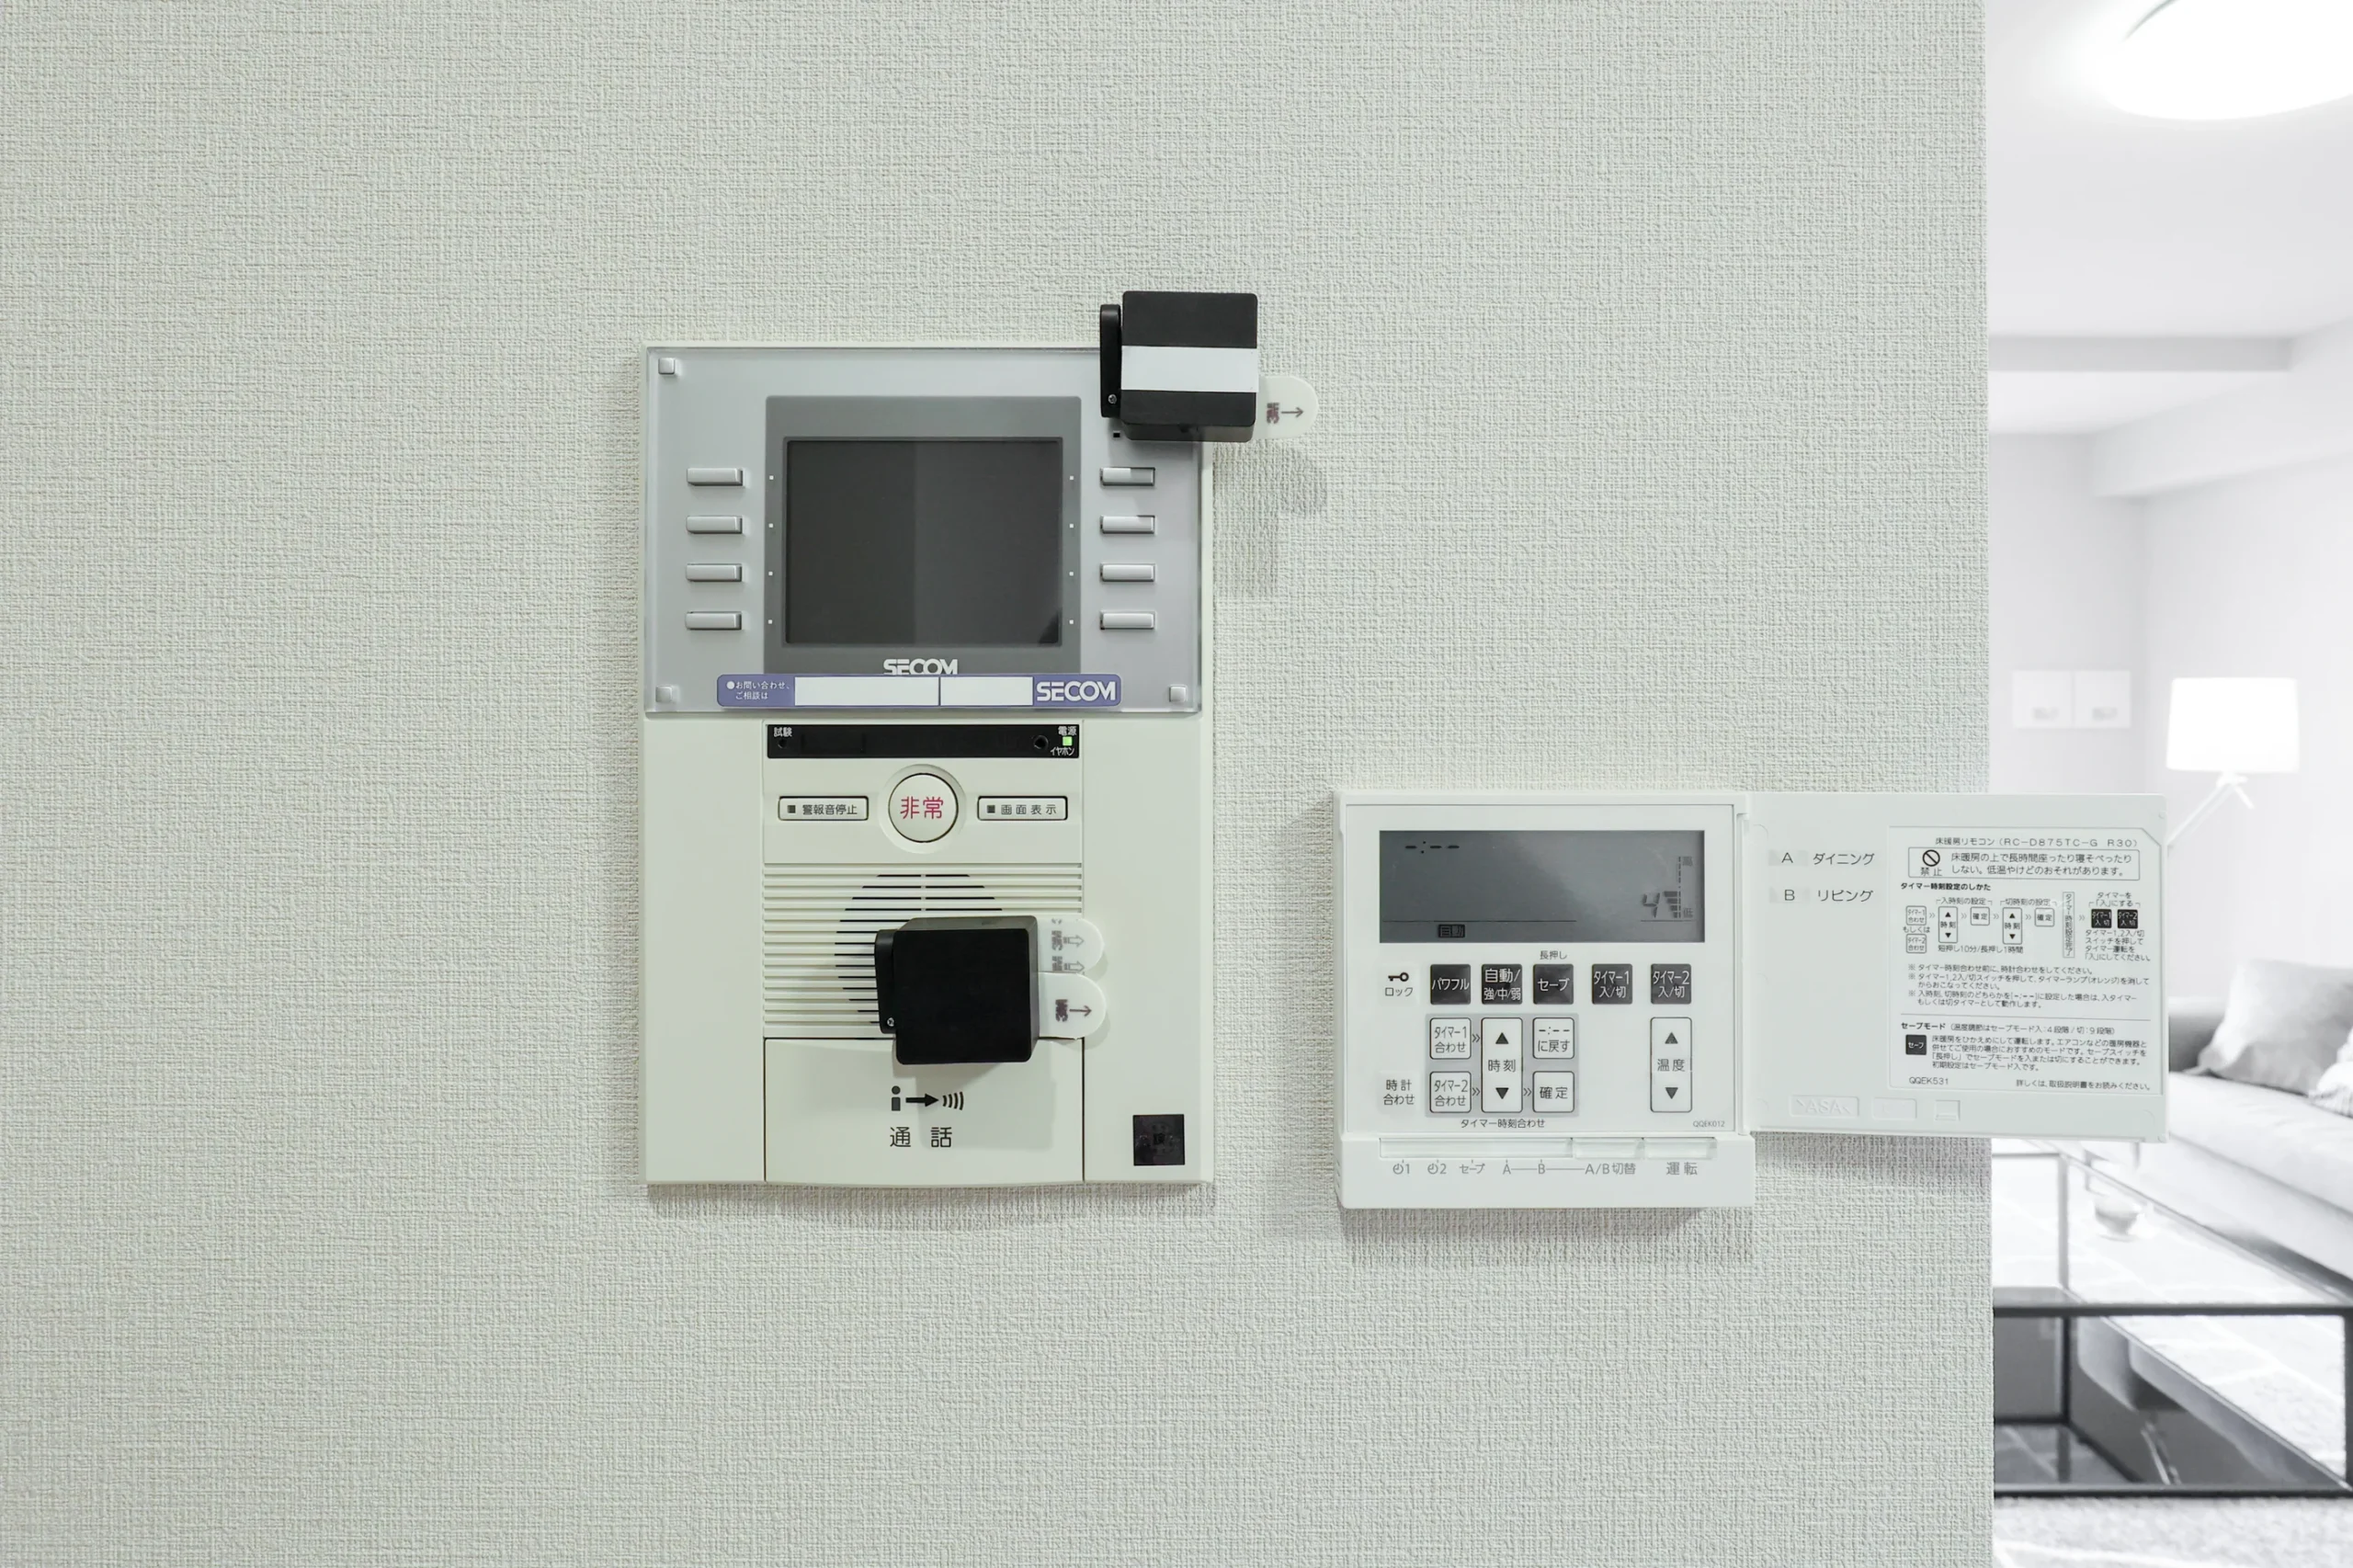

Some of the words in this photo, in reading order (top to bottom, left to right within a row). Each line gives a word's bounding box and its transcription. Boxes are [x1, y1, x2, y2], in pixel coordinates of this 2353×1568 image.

[883, 659, 958, 675] SECOM
[735, 691, 768, 699] ご相談は
[1036, 681, 1116, 701] SECOM
[774, 727, 792, 737] 試験
[1058, 726, 1076, 735] 電源
[1051, 747, 1074, 756] イヤホン
[802, 804, 858, 815] 警報音停止
[901, 796, 943, 819] 非常
[1001, 804, 1056, 814] 画面表示
[1781, 853, 1793, 863] A
[1813, 853, 1874, 865] ダイニング
[1920, 867, 1942, 877] 禁止
[1901, 882, 1991, 891] タイマー時刻設定のしかた
[1785, 890, 1794, 901] B
[1818, 890, 1873, 903] リビング
[1941, 897, 1985, 905] 入時刻の設定
[1643, 892, 1660, 918] 4
[1940, 921, 1956, 929] 時刻
[2005, 922, 2020, 930] 時刻
[2086, 937, 2143, 946] スイッチを押して
[1540, 950, 1567, 960] 長押し
[1484, 968, 1520, 983] 自動/
[1594, 971, 1630, 985] タイマー1
[1653, 971, 1689, 985] タイマー2
[1432, 978, 1469, 991] パワフル
[1538, 978, 1569, 991] セーブ
[1384, 987, 1413, 997] ロック
[1599, 986, 1626, 998] 入/切
[1658, 986, 1686, 998] 入/切
[1434, 1026, 1468, 1039] タイマー1
[1901, 1022, 1946, 1031] セーブモード
[1435, 1041, 1466, 1053] 合わせ
[1538, 1039, 1570, 1052] に戻す
[1488, 1059, 1516, 1073] 時刻
[1657, 1059, 1686, 1073] 温度
[1386, 1080, 1412, 1091] 時計
[1434, 1079, 1468, 1093] タイマー2
[1909, 1077, 1949, 1085] QQEK531
[1540, 1086, 1567, 1099] 確定
[1384, 1094, 1415, 1106] 合わせ
[1435, 1095, 1466, 1107] 合わせ
[1461, 1119, 1545, 1129] タイマー時刻合わせ
[889, 1127, 953, 1149] 通話
[1460, 1165, 1484, 1175] セーブ
[1503, 1165, 1511, 1174] A
[1539, 1165, 1545, 1174] B
[1586, 1163, 1636, 1175] A/B切替
[1666, 1162, 1697, 1176] 運転
